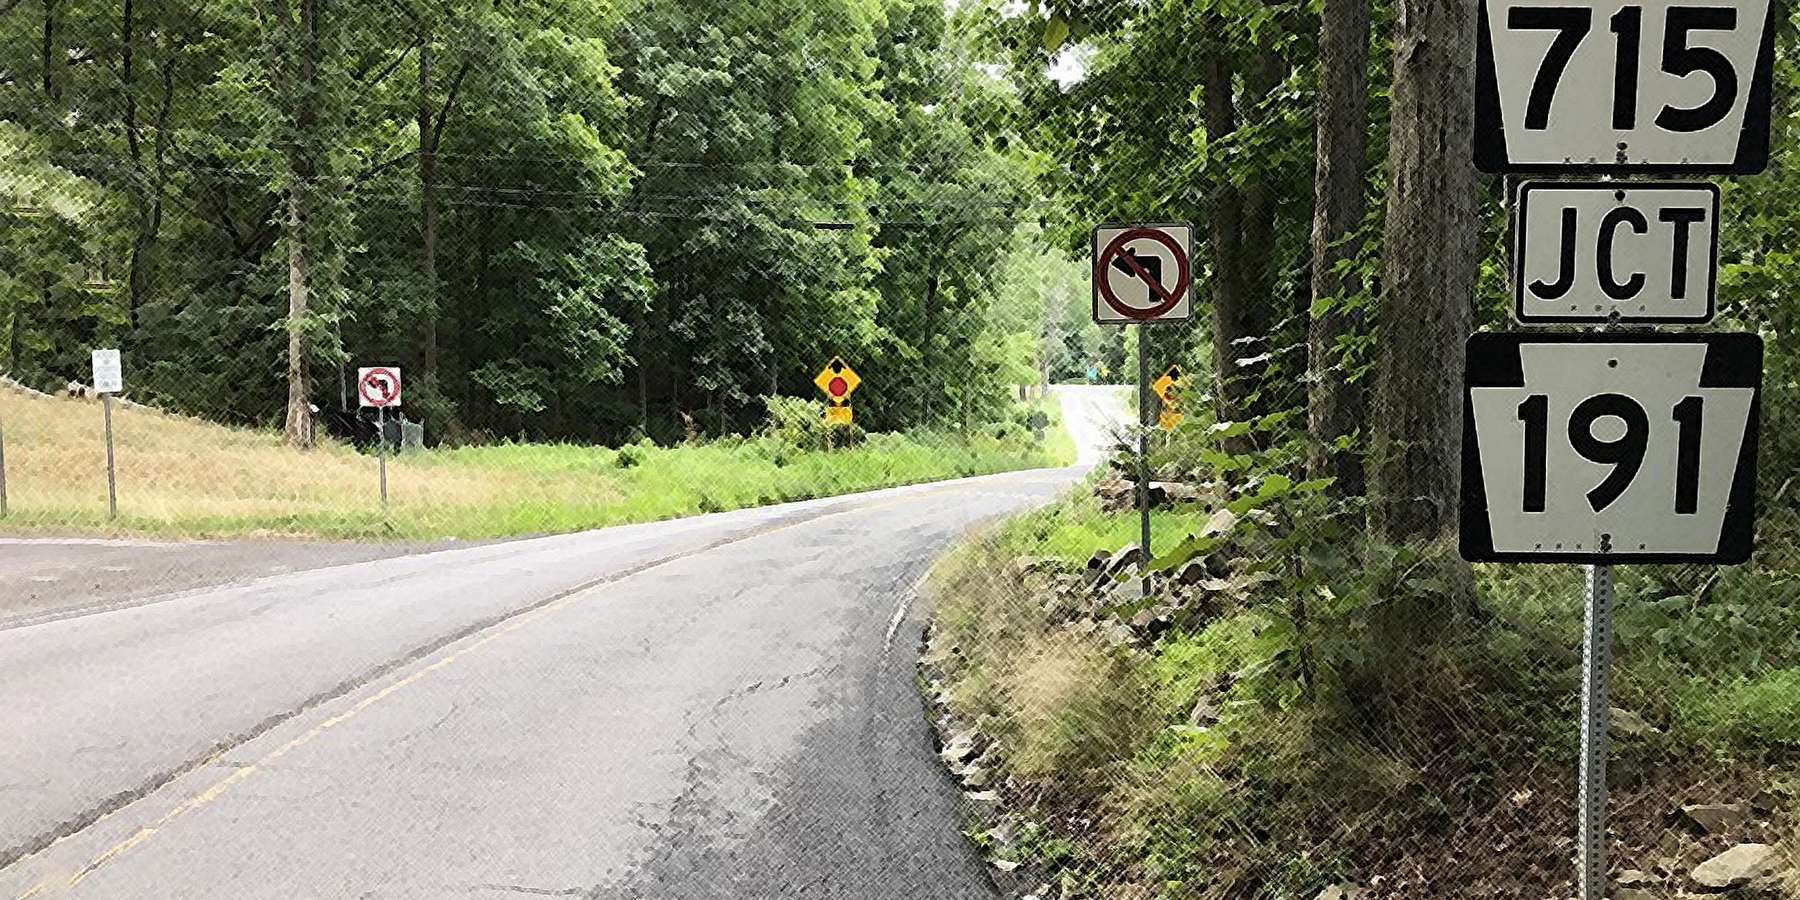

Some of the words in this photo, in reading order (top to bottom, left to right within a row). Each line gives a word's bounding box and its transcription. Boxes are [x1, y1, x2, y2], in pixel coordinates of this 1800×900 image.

[1508, 6, 1738, 132] 715
[1528, 206, 1706, 300] JCT
[1517, 393, 1704, 514] 191
